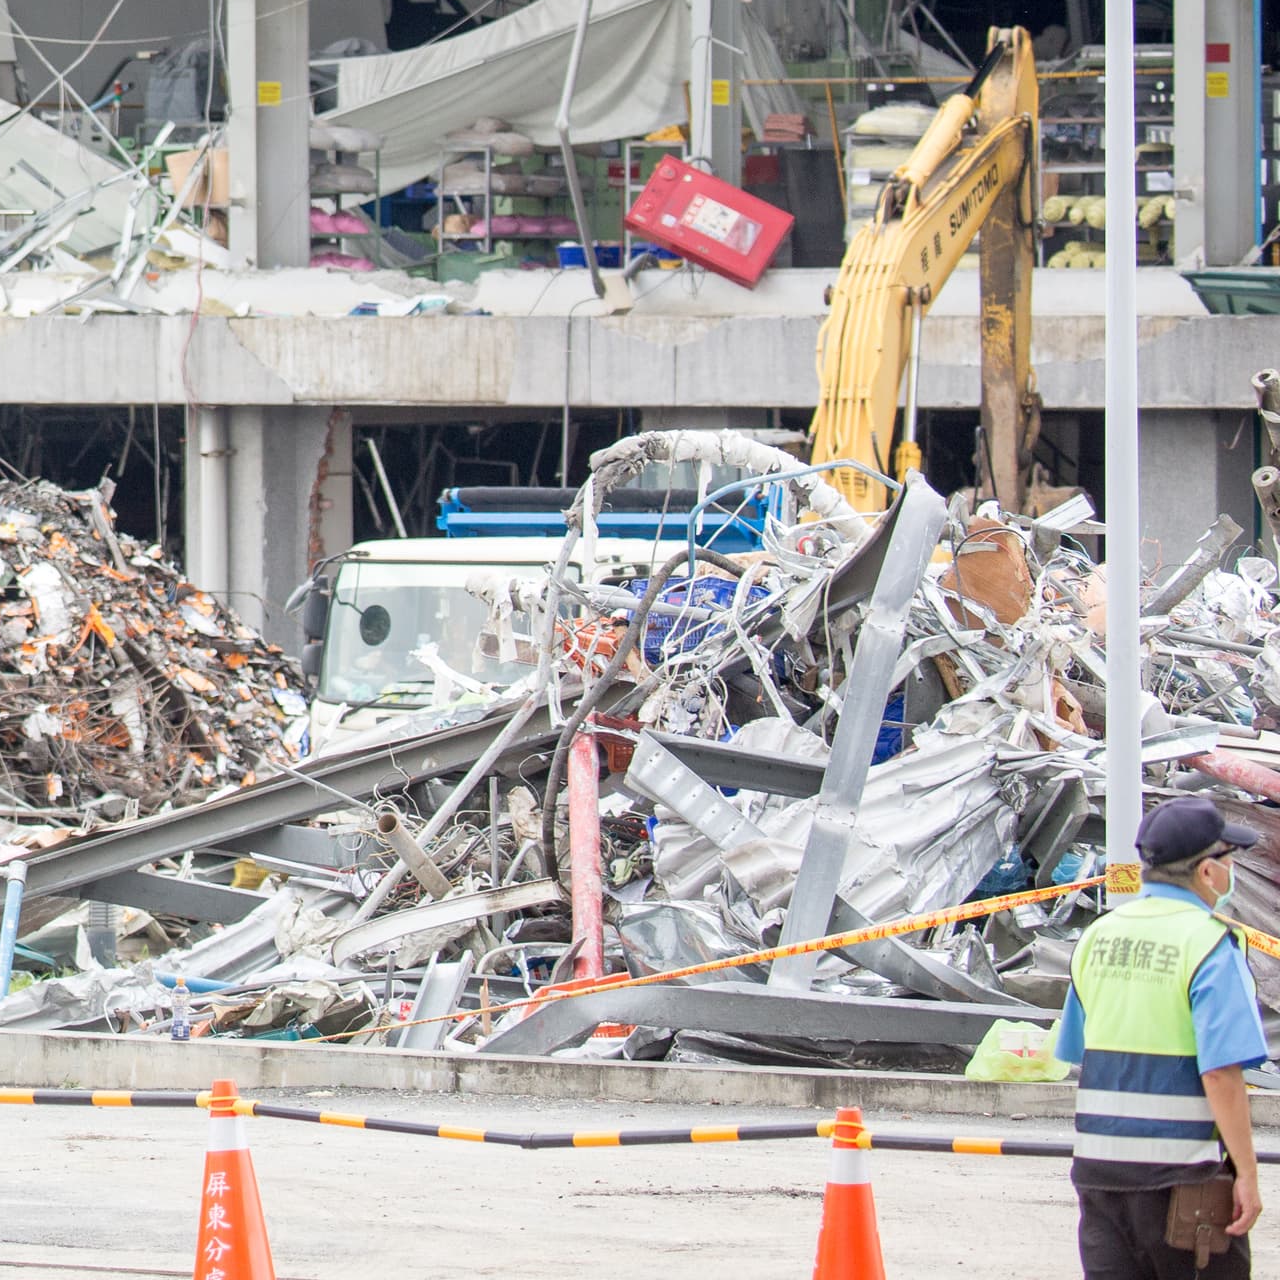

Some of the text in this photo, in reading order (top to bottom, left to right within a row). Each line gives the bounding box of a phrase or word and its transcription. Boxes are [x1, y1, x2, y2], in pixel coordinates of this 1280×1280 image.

[949, 163, 999, 237] SUMITOMO
[1090, 936, 1180, 974] 先鋒保全
